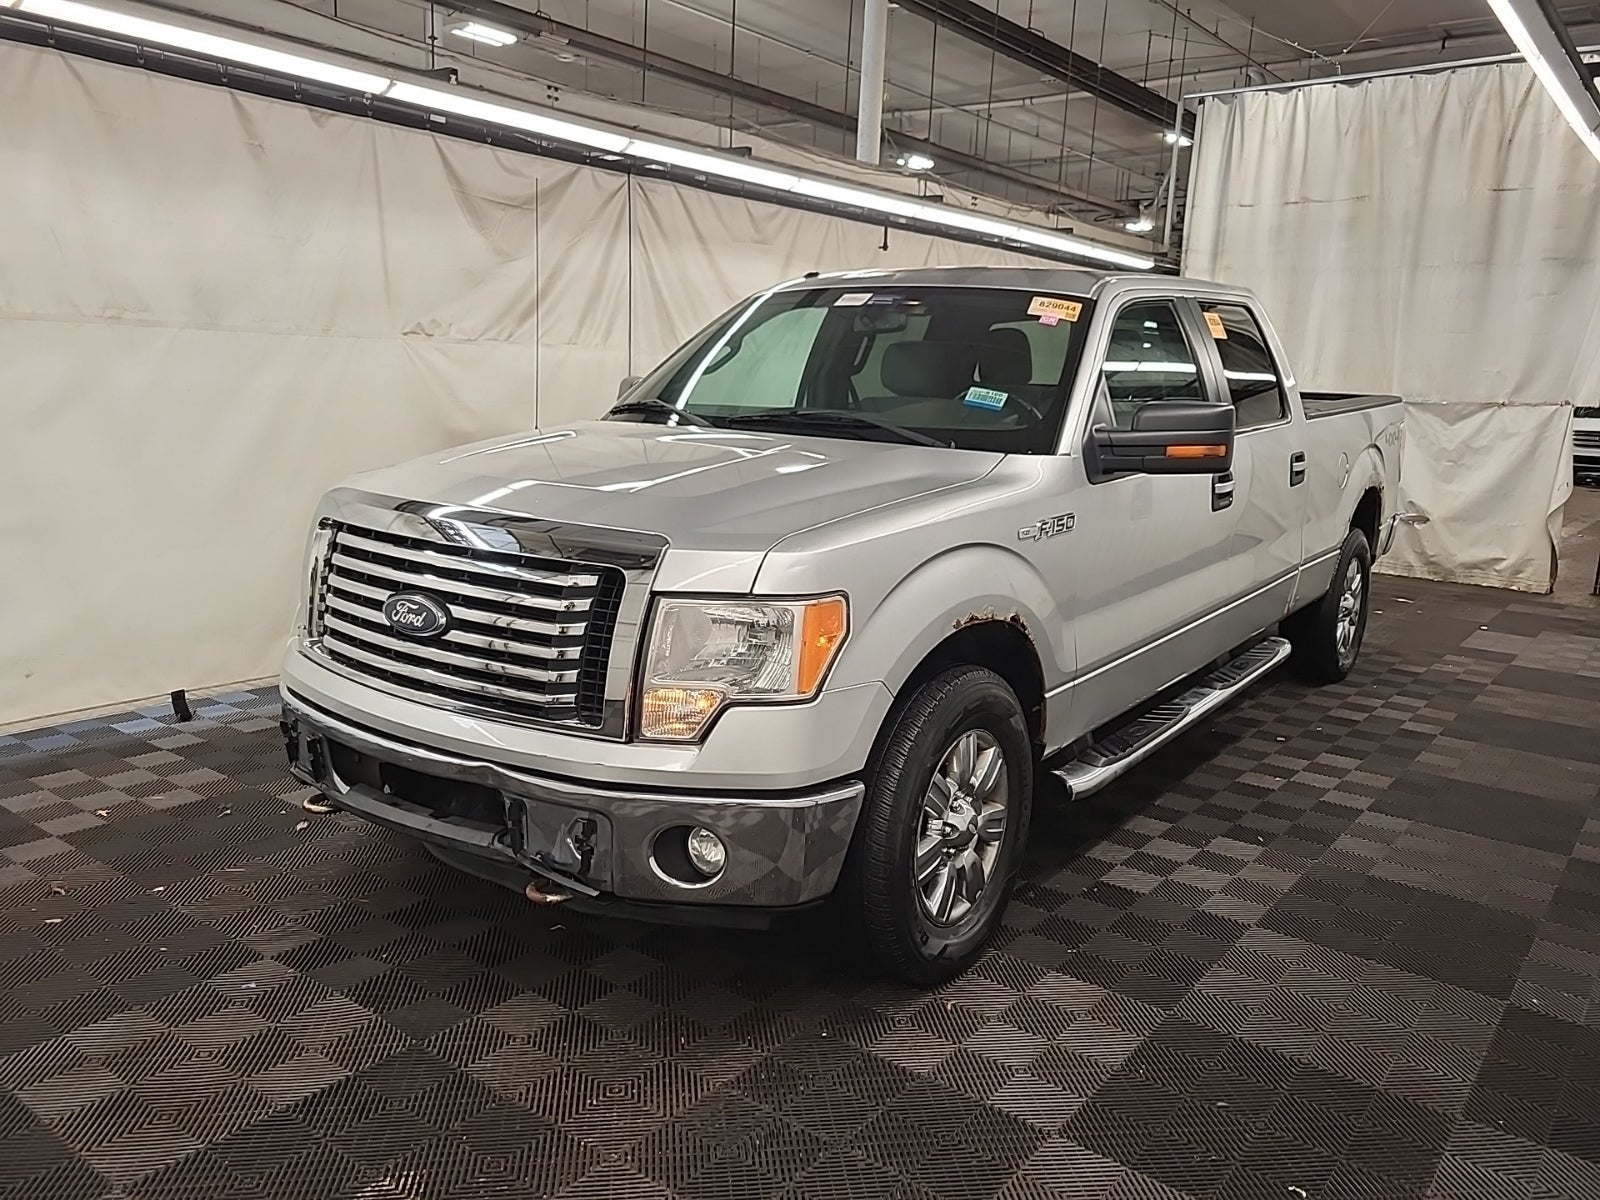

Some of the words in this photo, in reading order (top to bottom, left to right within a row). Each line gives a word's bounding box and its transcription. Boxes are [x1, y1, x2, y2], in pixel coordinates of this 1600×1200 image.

[1038, 301, 1077, 312] 829044
[1038, 513, 1076, 538] F-150
[391, 600, 427, 627] Ford
